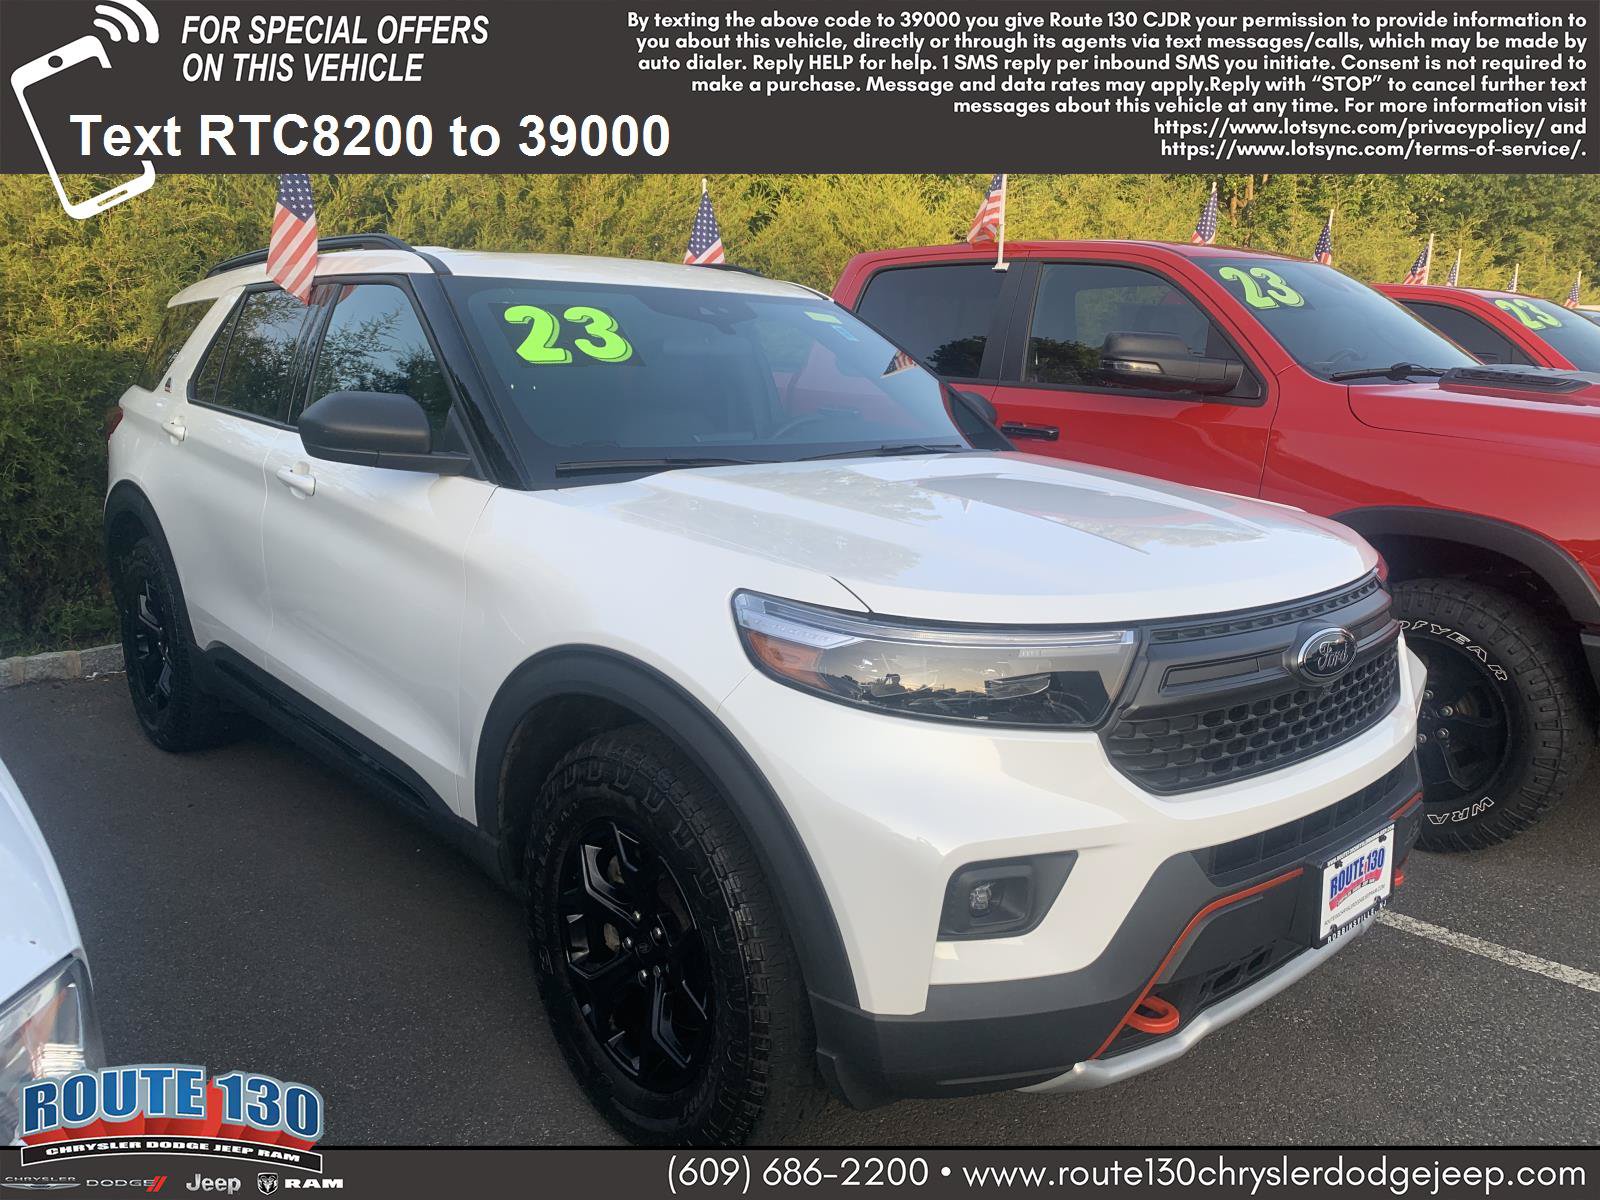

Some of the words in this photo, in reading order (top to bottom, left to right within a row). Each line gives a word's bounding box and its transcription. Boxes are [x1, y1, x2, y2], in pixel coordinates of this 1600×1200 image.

[1219, 267, 1304, 308] 23
[504, 305, 633, 364] 23
[1494, 299, 1562, 330] 23
[1318, 640, 1349, 671] Ford
[1329, 855, 1366, 899] ROUTE
[1366, 847, 1385, 873] 130
